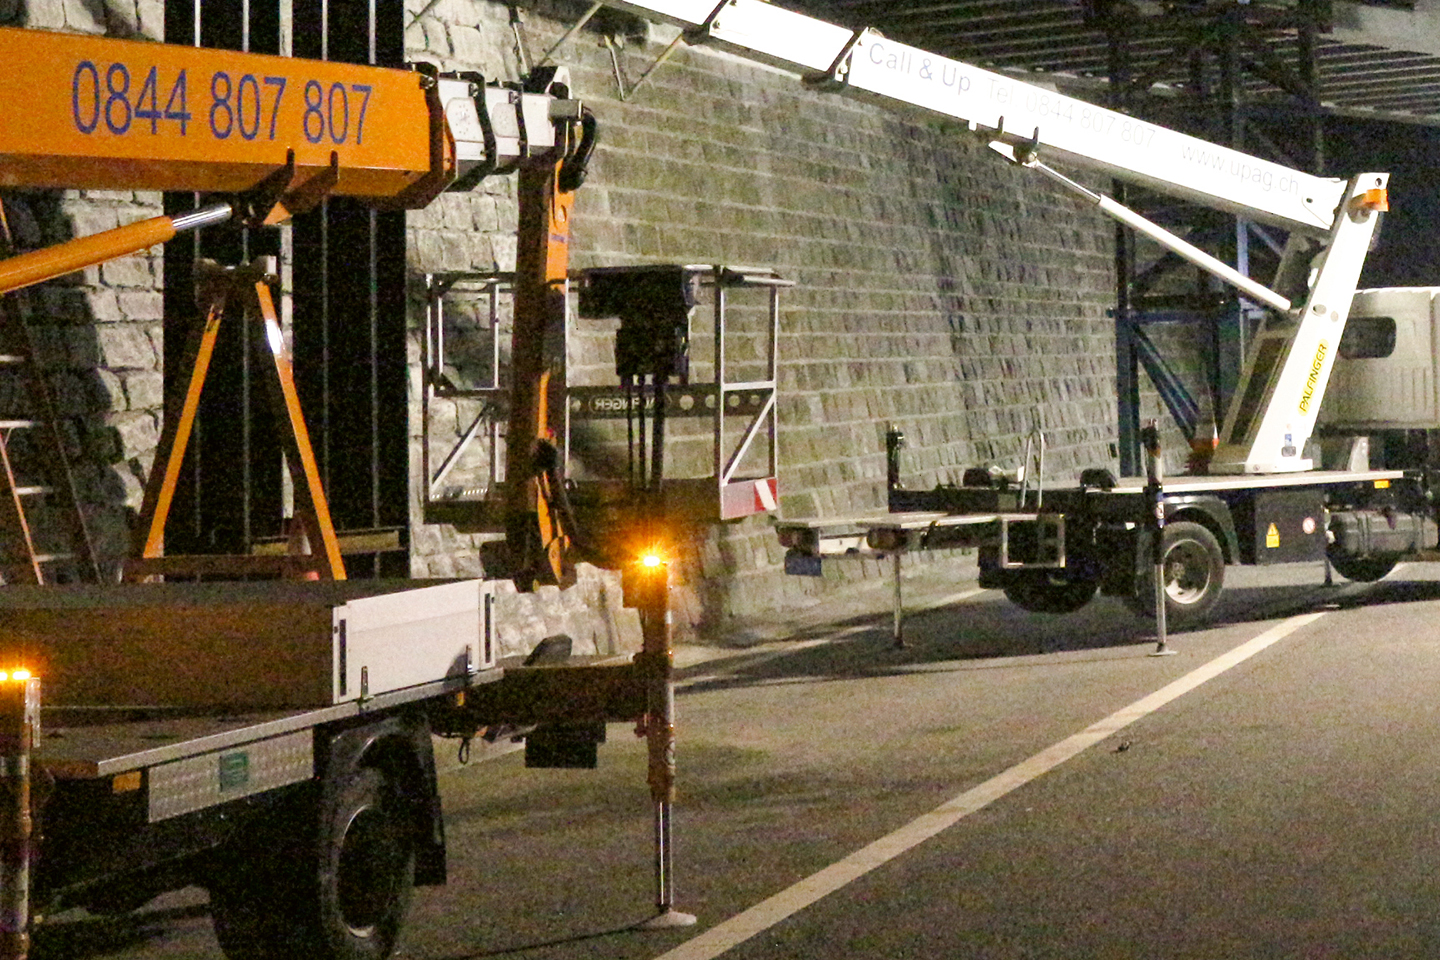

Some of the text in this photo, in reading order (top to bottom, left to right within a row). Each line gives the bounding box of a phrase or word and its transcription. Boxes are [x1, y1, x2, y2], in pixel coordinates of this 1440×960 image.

[72, 60, 372, 145] 0844 807 807
[869, 43, 912, 74] Call
[919, 58, 932, 80] &
[942, 64, 970, 95] Up
[1026, 94, 1073, 123] 0844
[1081, 108, 1116, 135] 807
[1121, 120, 1156, 148] 807
[1181, 144, 1299, 194] www.upag.ch
[1299, 342, 1328, 412] PALFINGER
